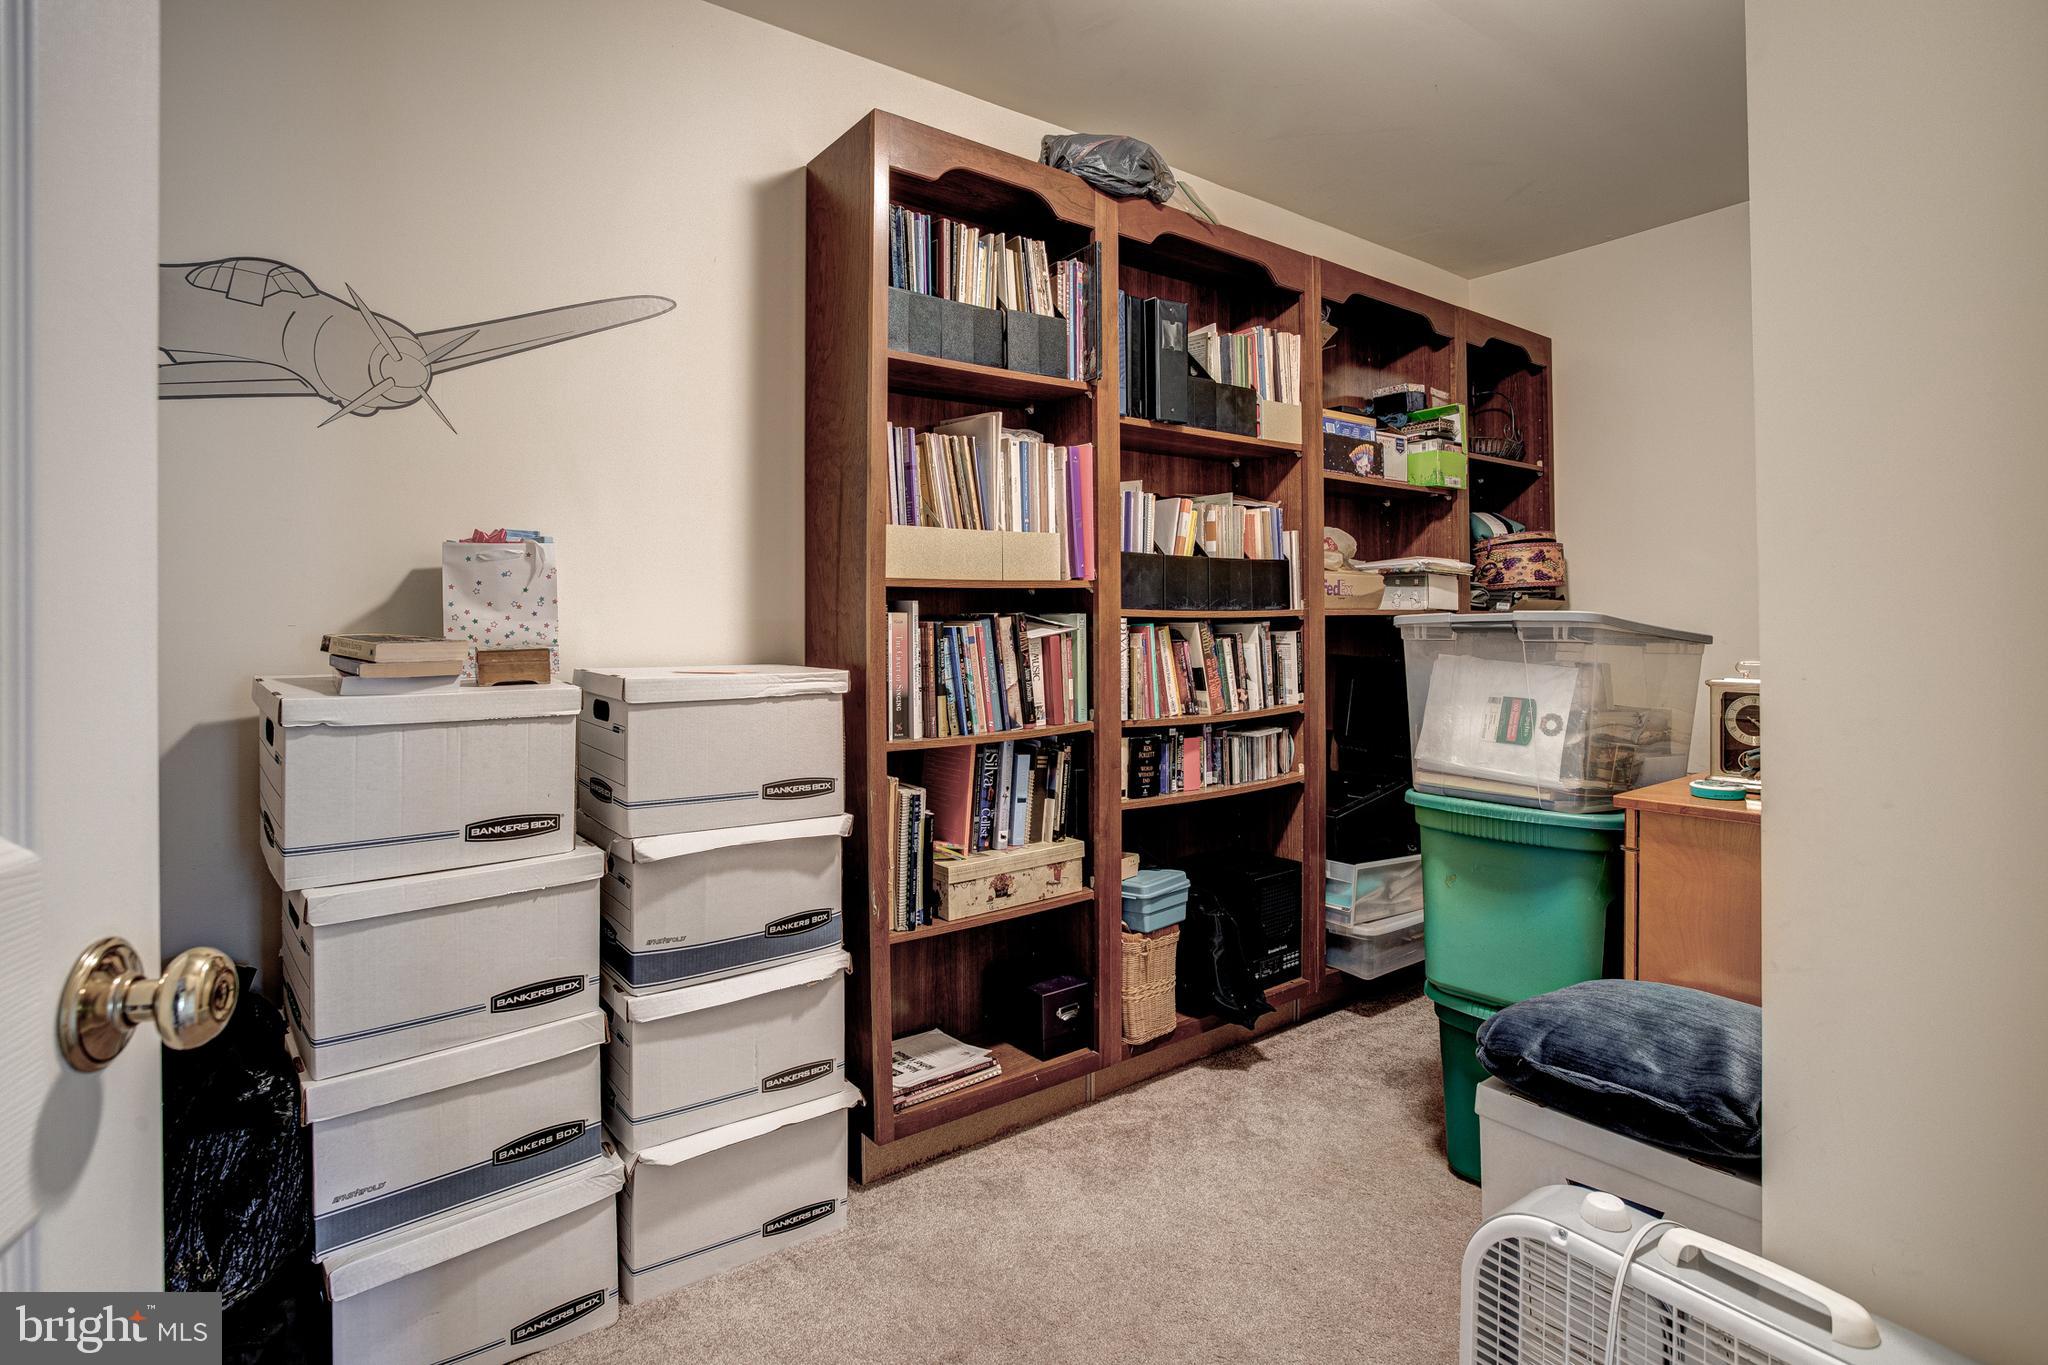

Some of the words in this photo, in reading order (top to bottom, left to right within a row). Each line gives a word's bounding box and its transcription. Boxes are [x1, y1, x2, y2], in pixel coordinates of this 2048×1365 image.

[1031, 653, 1040, 682] MUSIC
[983, 752, 999, 788] Silva
[766, 785, 812, 795] BANKERS
[812, 782, 832, 791] BOX
[471, 822, 529, 836] BANKERS
[530, 819, 556, 829] BOX
[979, 807, 991, 838] Cellist
[769, 918, 810, 933] BANKERS
[811, 913, 828, 924] BOX
[496, 987, 554, 1007] BANKERS
[555, 980, 580, 993] BOX
[766, 1070, 811, 1088] BANKERS
[811, 1064, 830, 1076] BOX
[499, 1136, 553, 1159] BANKERS
[556, 1126, 578, 1140] BOX
[767, 1210, 811, 1232] BANKERS
[811, 1204, 832, 1217] BOX
[516, 1308, 574, 1339] BANKERS
[575, 1296, 600, 1312] BOX
